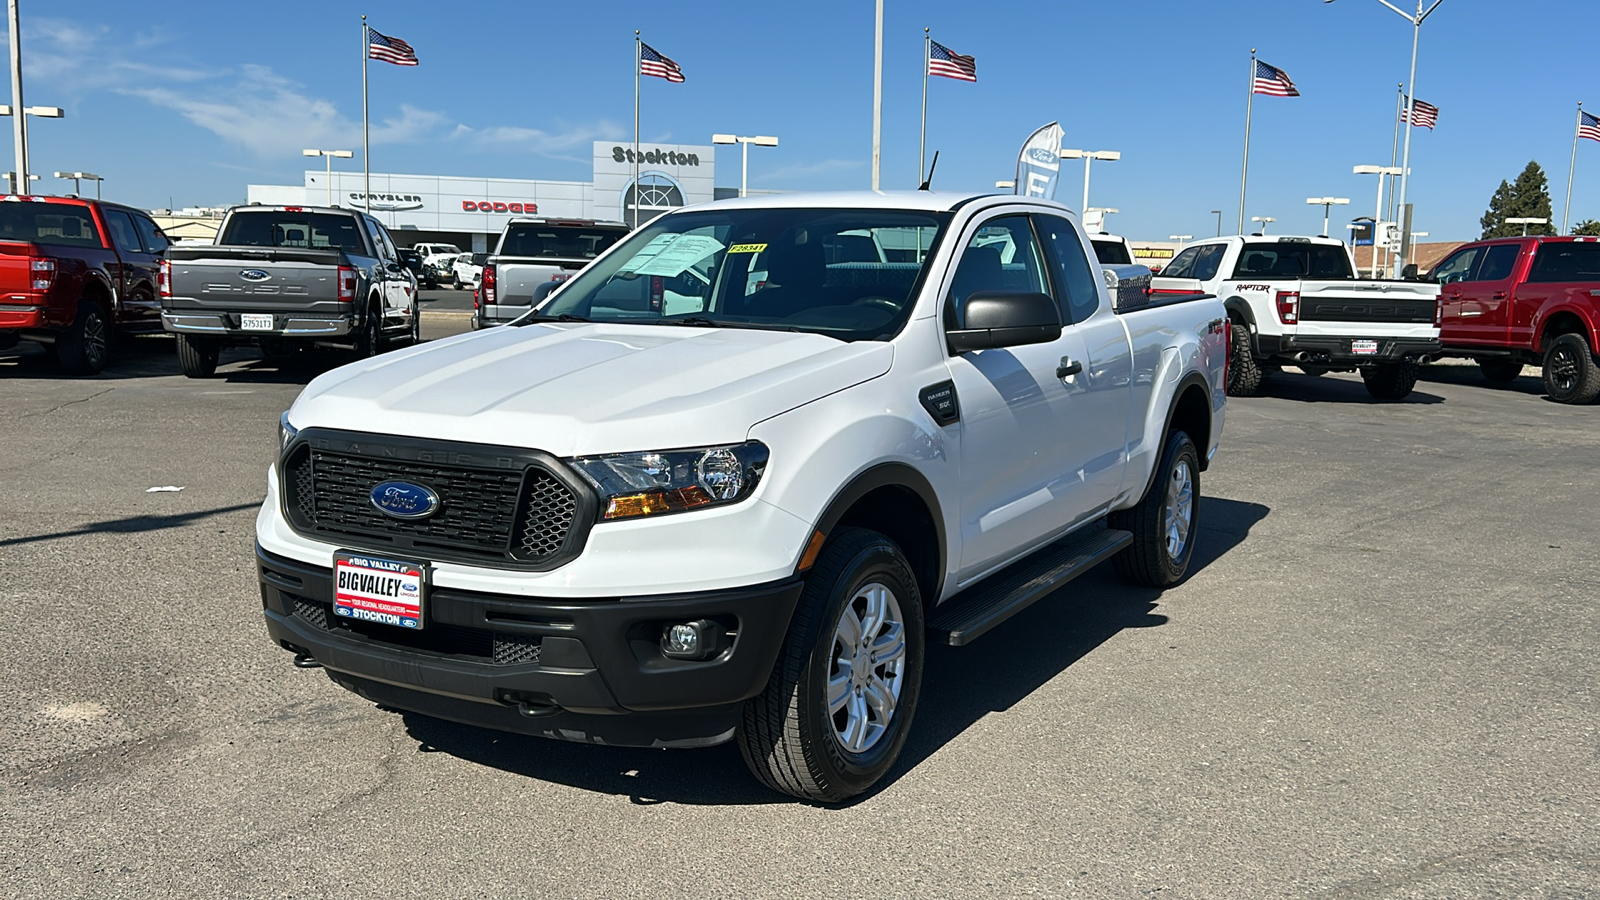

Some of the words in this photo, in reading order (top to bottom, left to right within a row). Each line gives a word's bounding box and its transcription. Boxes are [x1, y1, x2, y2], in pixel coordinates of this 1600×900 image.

[612, 146, 699, 166] Stockton
[1033, 149, 1055, 163] Ford
[349, 193, 422, 202] CHRYSLER
[462, 200, 538, 214] DODGE
[201, 281, 309, 296] F-150
[1235, 284, 1270, 293] RAPTOR
[927, 390, 950, 401] RANGER
[316, 439, 514, 468] RANGER
[381, 486, 417, 510] Ford
[353, 557, 368, 567] BIG
[369, 560, 400, 571] VALLEY
[338, 570, 402, 598] BIGVALLEY
[351, 598, 361, 606] YOUR
[361, 600, 378, 609] REGIONAL
[378, 603, 406, 614] HEADQUARTERS
[352, 608, 400, 625] STOCKTON
